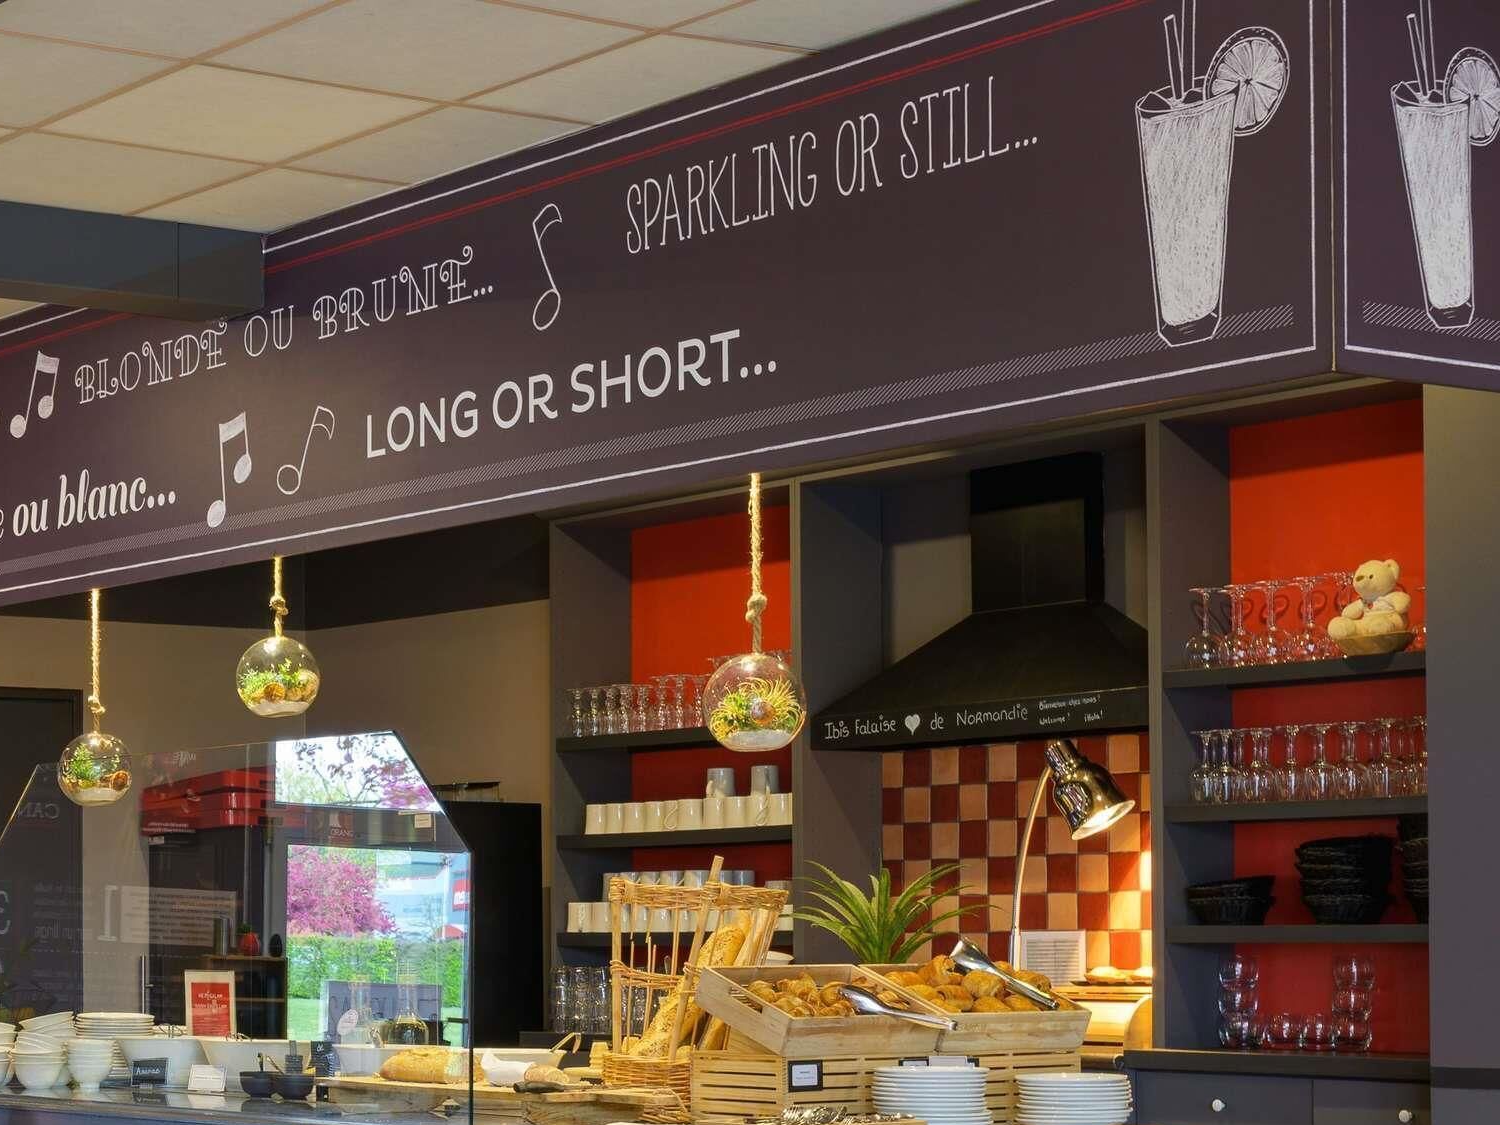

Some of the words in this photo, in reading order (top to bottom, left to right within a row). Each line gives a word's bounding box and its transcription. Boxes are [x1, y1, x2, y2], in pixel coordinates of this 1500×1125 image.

[626, 131, 818, 255] SPARKLING
[835, 111, 883, 197] OR
[899, 75, 1039, 181] STILL...
[73, 320, 228, 404] BLONDE
[244, 304, 295, 357] OU
[312, 244, 494, 341] BRUNE...
[365, 390, 480, 459] LONG
[492, 372, 558, 430] OR
[570, 328, 778, 414] SHORT...
[12, 502, 48, 537] ou
[57, 468, 177, 530] blanc...
[824, 719, 850, 741] Ibis
[929, 712, 945, 731] de
